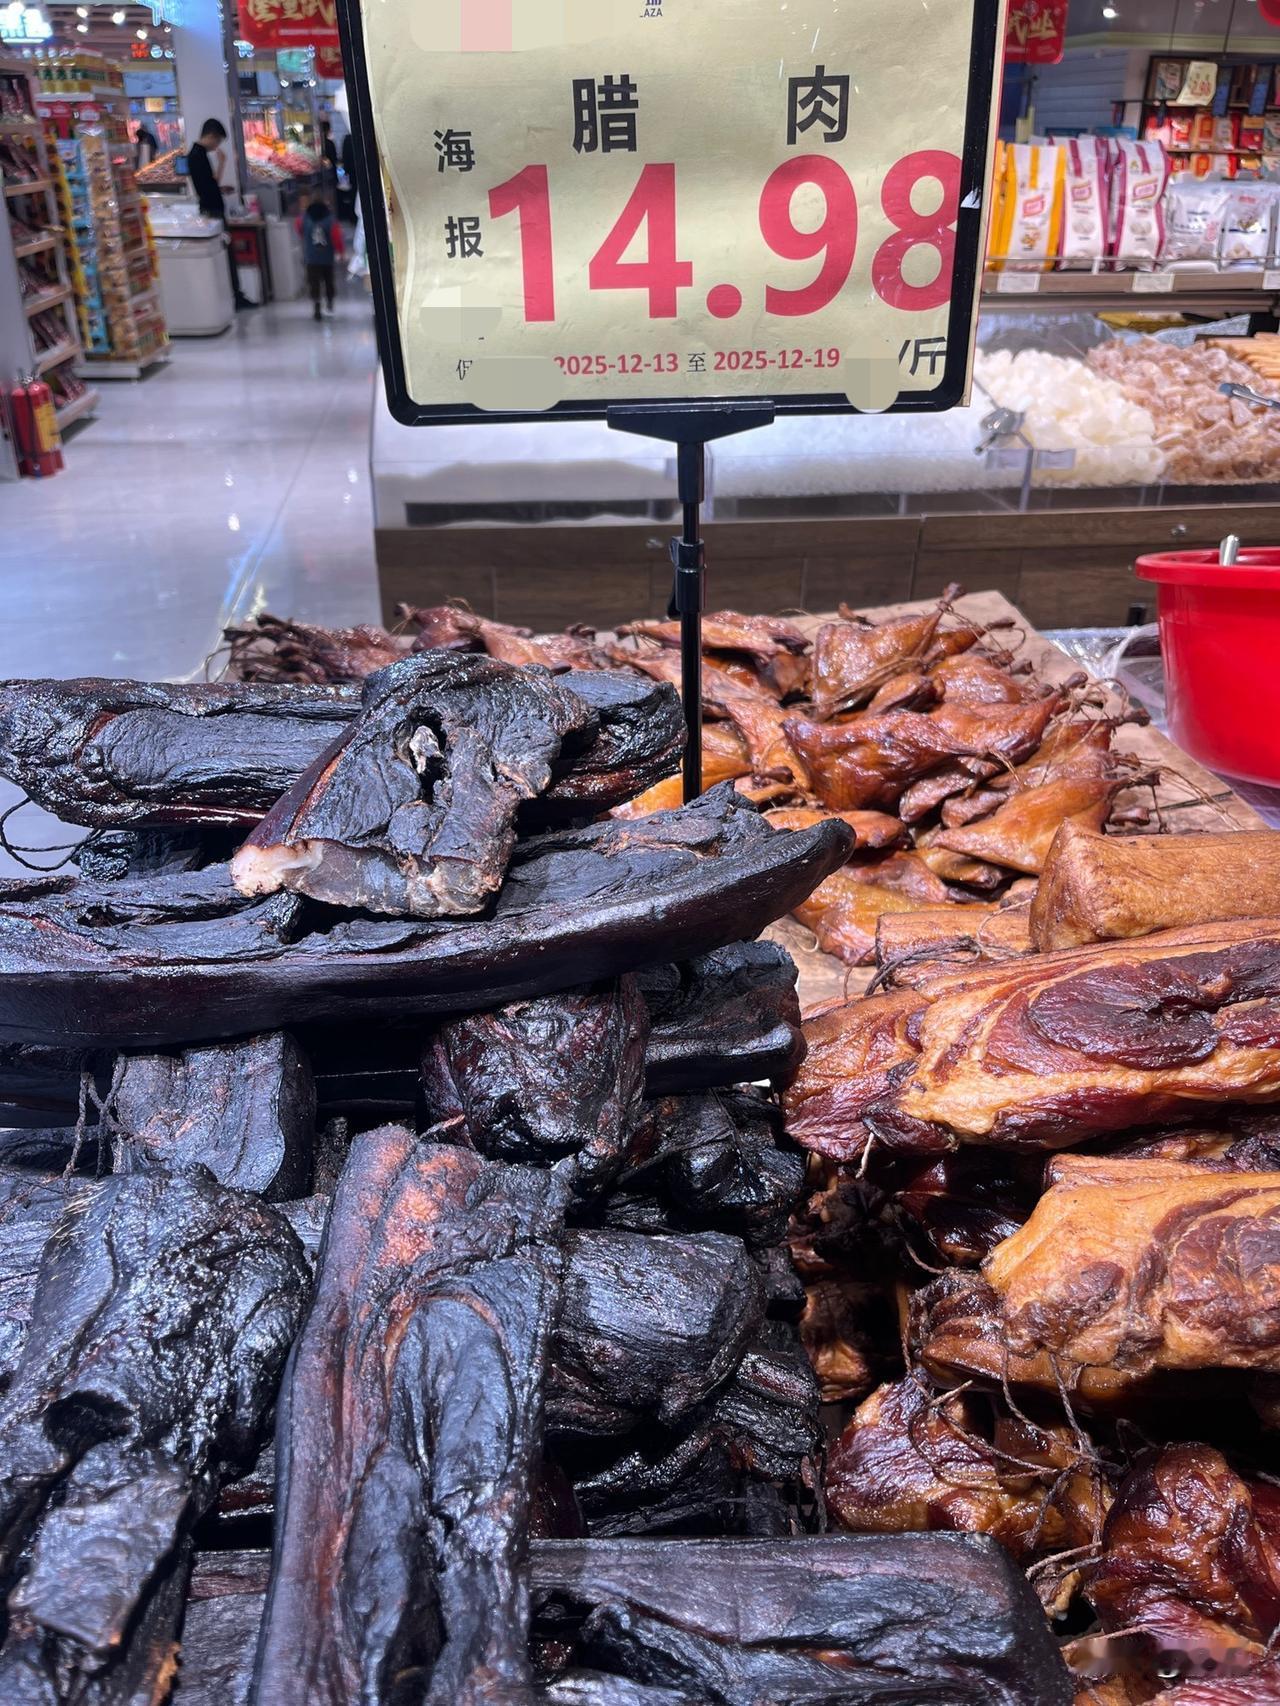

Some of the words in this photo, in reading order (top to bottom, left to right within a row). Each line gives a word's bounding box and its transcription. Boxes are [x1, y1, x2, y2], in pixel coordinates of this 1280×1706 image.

[640, 8, 663, 17] AZA
[572, 65, 850, 154] 腊肉
[433, 129, 484, 259] 海报
[488, 150, 963, 322] 14.98
[687, 352, 707, 373] 至
[713, 348, 840, 371] 2025-12-19
